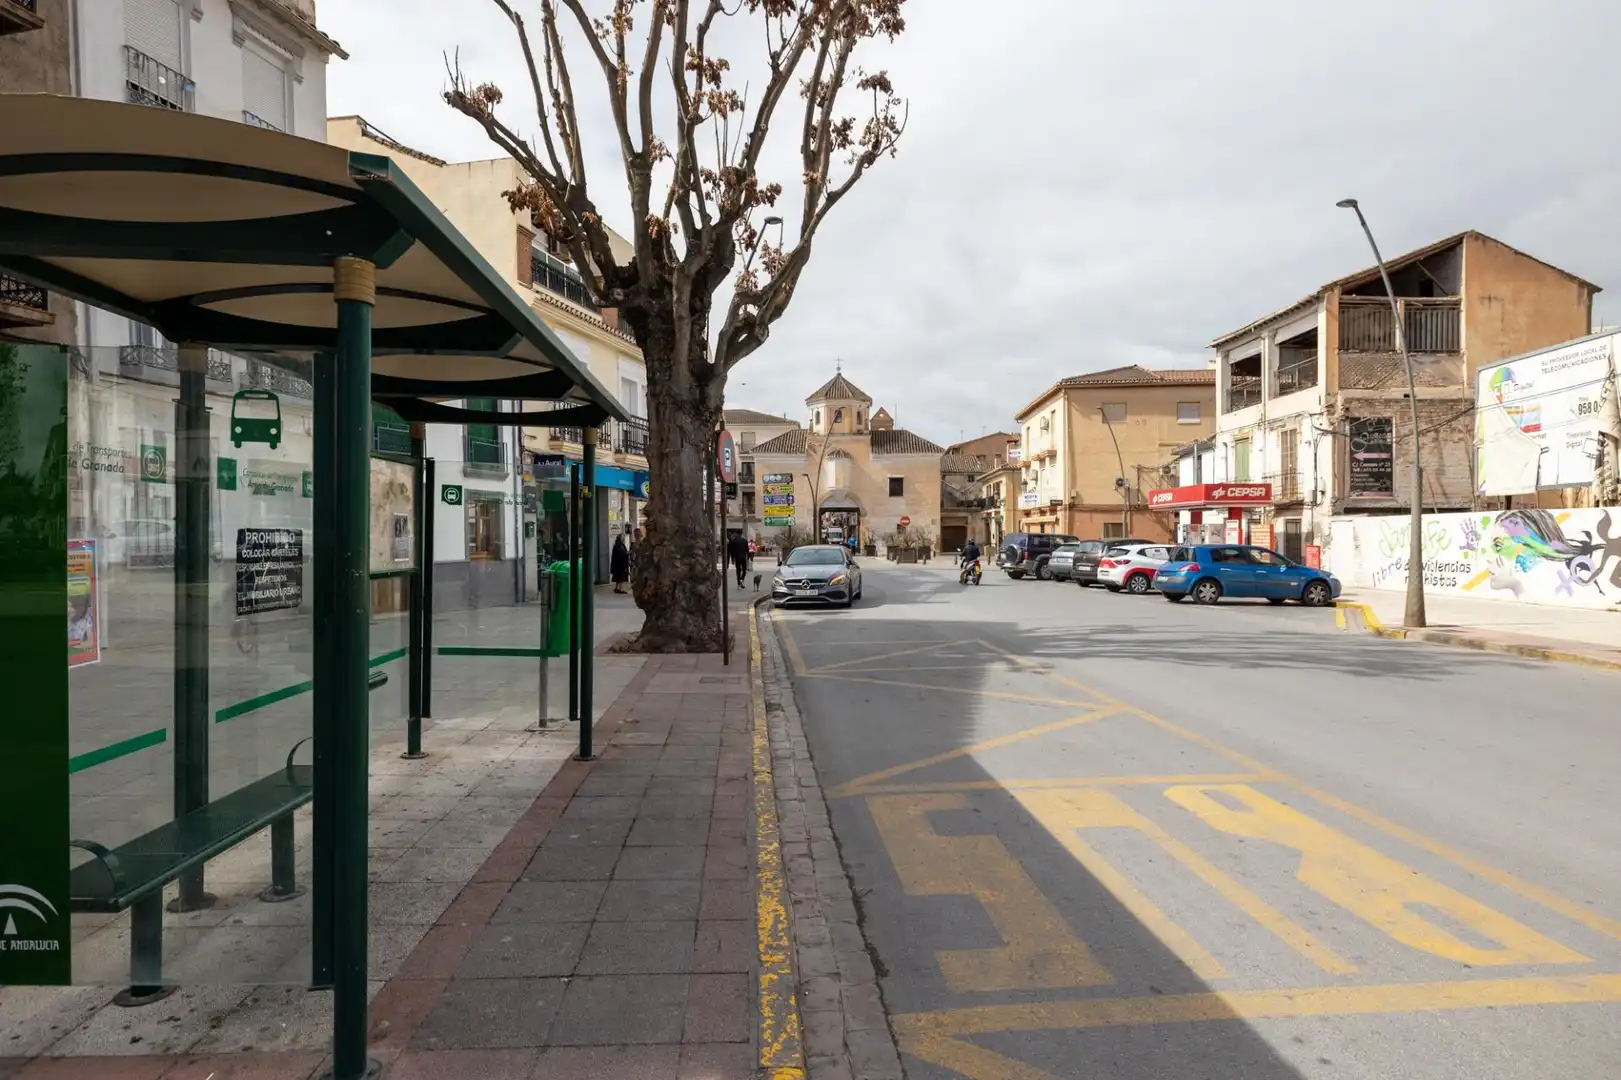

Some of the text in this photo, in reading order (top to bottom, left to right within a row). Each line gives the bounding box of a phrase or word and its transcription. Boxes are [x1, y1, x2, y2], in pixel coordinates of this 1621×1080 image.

[1578, 402, 1592, 416] 958
[81, 458, 125, 474] Granada
[1157, 492, 1174, 503] CEPSA
[1227, 487, 1266, 497] CEPSA
[242, 547, 299, 558] COLOCAR CARTELES
[1371, 556, 1402, 588] libre
[1422, 560, 1472, 574] violencias
[866, 782, 1594, 992] BUS
